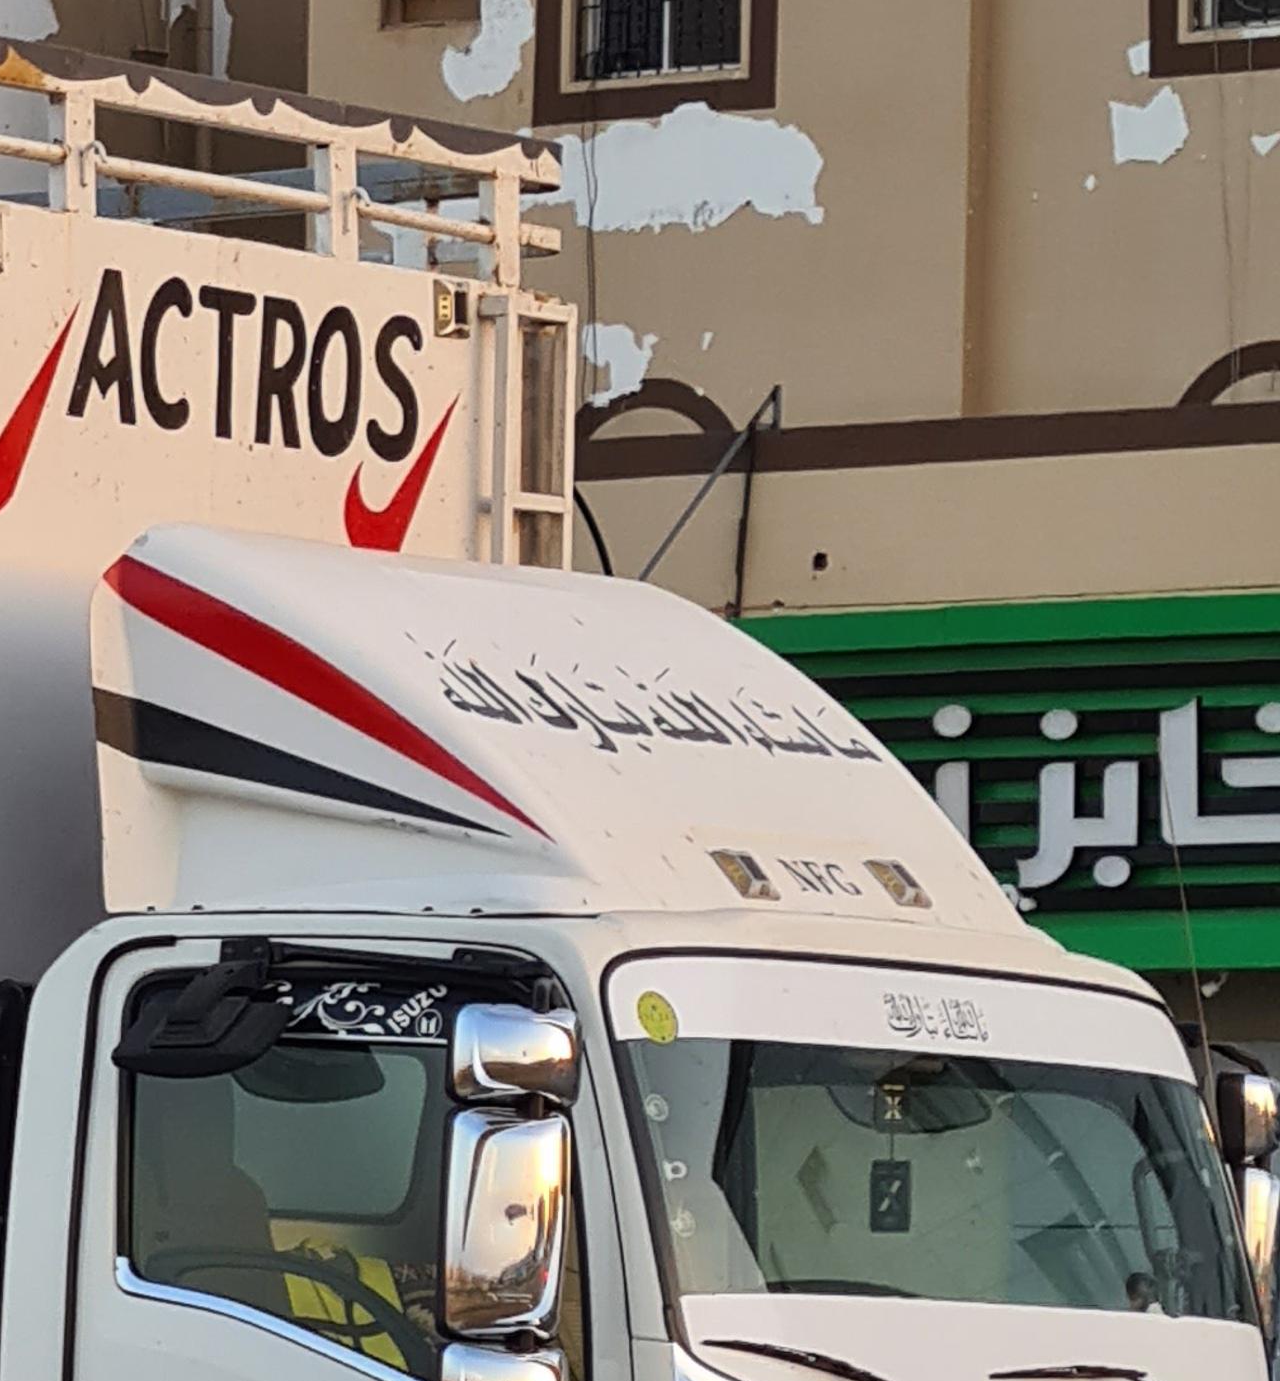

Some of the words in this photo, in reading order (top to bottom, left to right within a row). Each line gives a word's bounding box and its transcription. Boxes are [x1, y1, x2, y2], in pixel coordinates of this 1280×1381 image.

[67, 268, 423, 462] ACTROS
[422, 645, 534, 725] الله
[515, 656, 654, 754] تبارك
[634, 676, 749, 746] الله
[778, 859, 862, 897] NFG
[387, 984, 448, 1034] ISUZU
